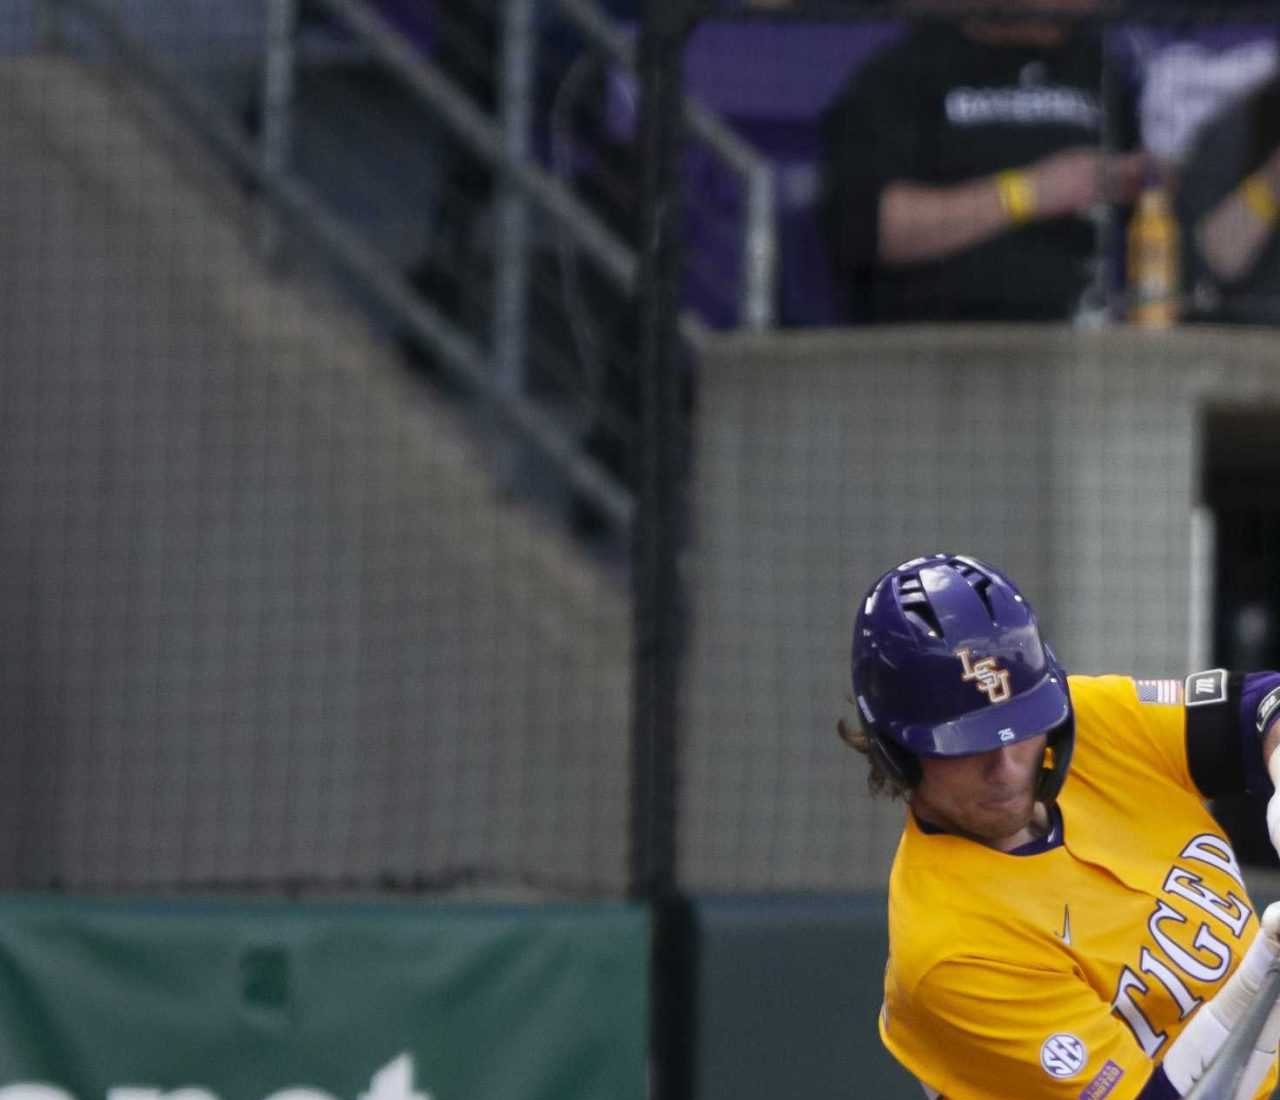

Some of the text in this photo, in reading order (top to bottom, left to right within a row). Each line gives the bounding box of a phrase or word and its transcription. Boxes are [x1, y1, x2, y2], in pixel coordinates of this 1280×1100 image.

[955, 646, 1011, 703] LSU
[997, 727, 1016, 742] 25
[1043, 1034, 1083, 1075] SEC
